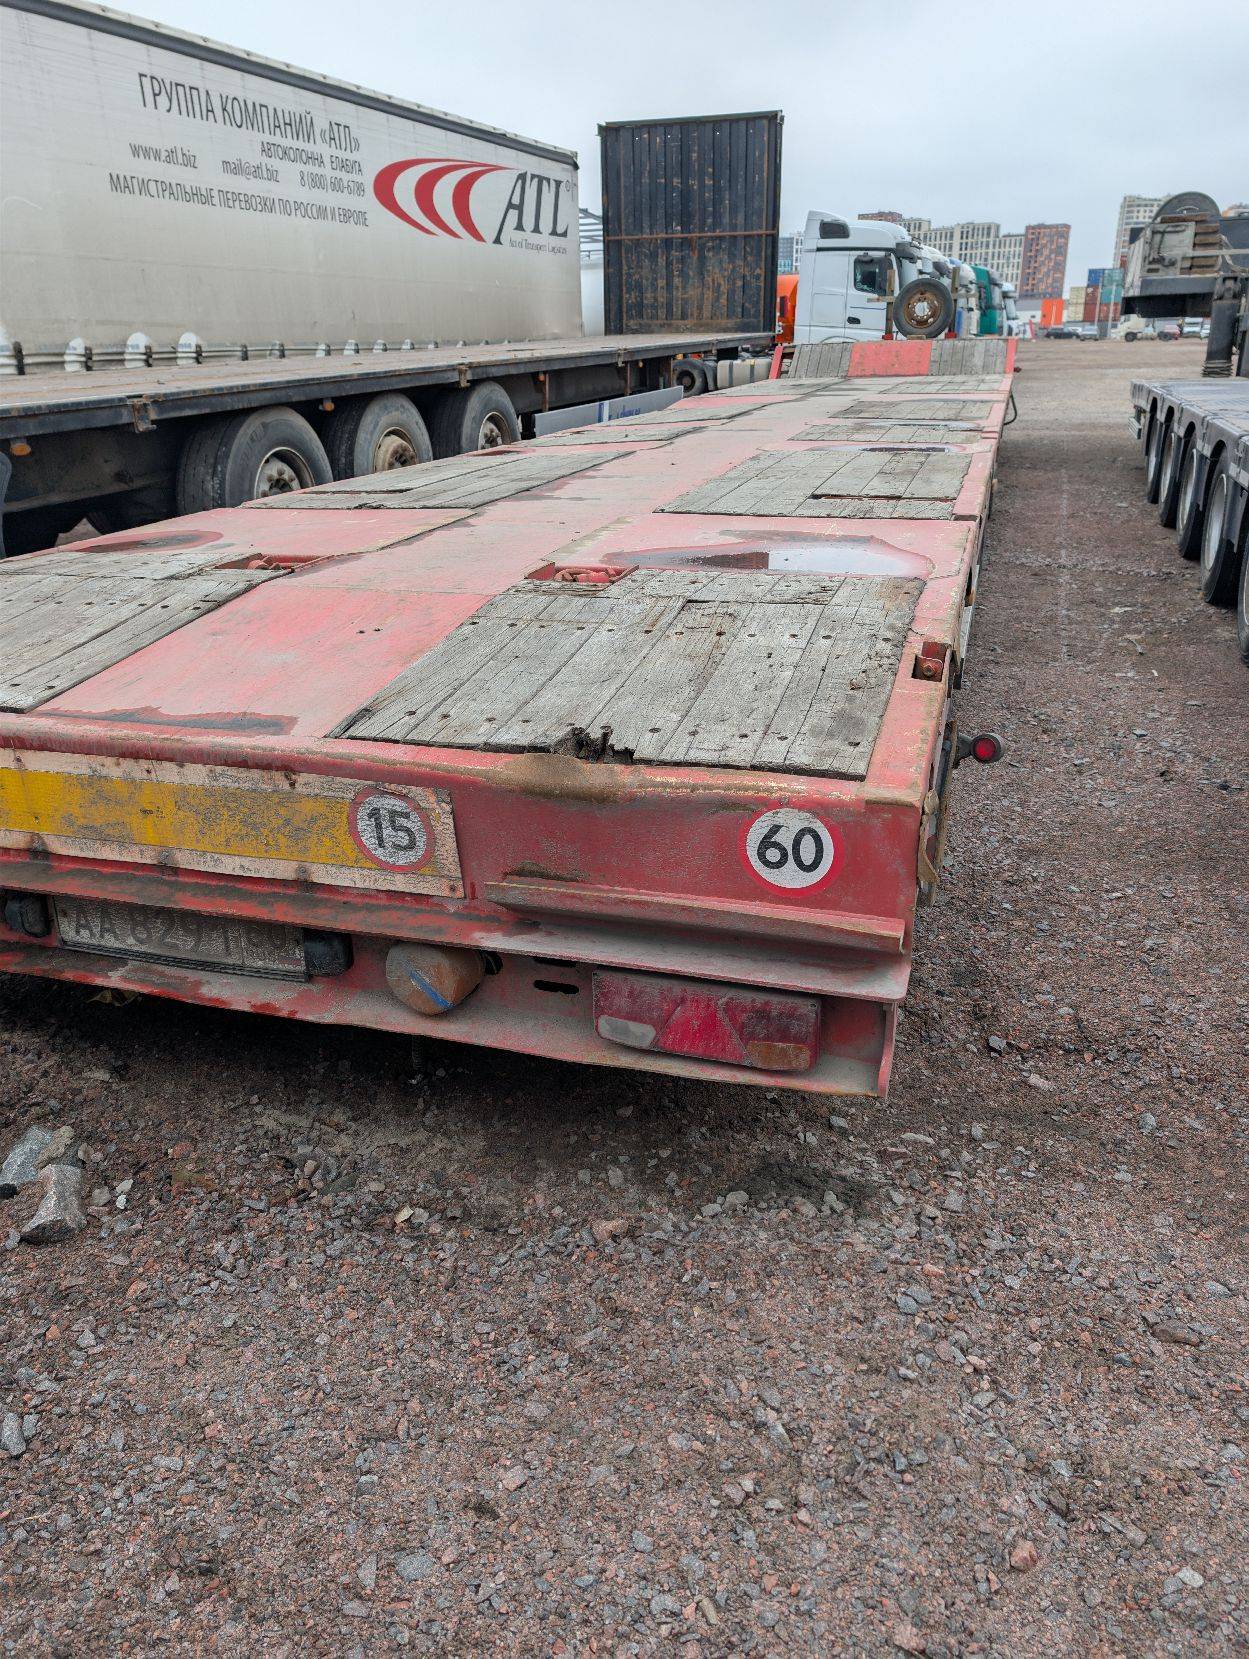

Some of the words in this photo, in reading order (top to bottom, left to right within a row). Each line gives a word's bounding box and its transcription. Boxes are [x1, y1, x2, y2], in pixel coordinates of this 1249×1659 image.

[138, 72, 217, 123] ГРУППА
[220, 93, 316, 145] КОМПАНИЙ
[320, 121, 360, 153] «АТЛ»
[129, 142, 198, 169] www.atl.biz
[222, 158, 280, 183] mail@atl.biz
[299, 170, 306, 187] 8
[307, 171, 328, 193] (800)
[330, 176, 365, 198] 600-6789
[260, 141, 325, 168] АВТОКОЛОННА
[330, 155, 363, 176] ЕЛАБУГА
[109, 172, 216, 207] МАГИСТРАЛЬНЫЕ
[218, 189, 276, 214] ПЕРЕВОЗКИ
[278, 198, 292, 217] ПО
[294, 200, 328, 221] РОССИИ
[330, 205, 337, 222] И
[338, 207, 369, 227] ЕВРОПЕ
[492, 170, 568, 245] ATL
[367, 807, 417, 852] 15
[757, 824, 824, 874] 60
